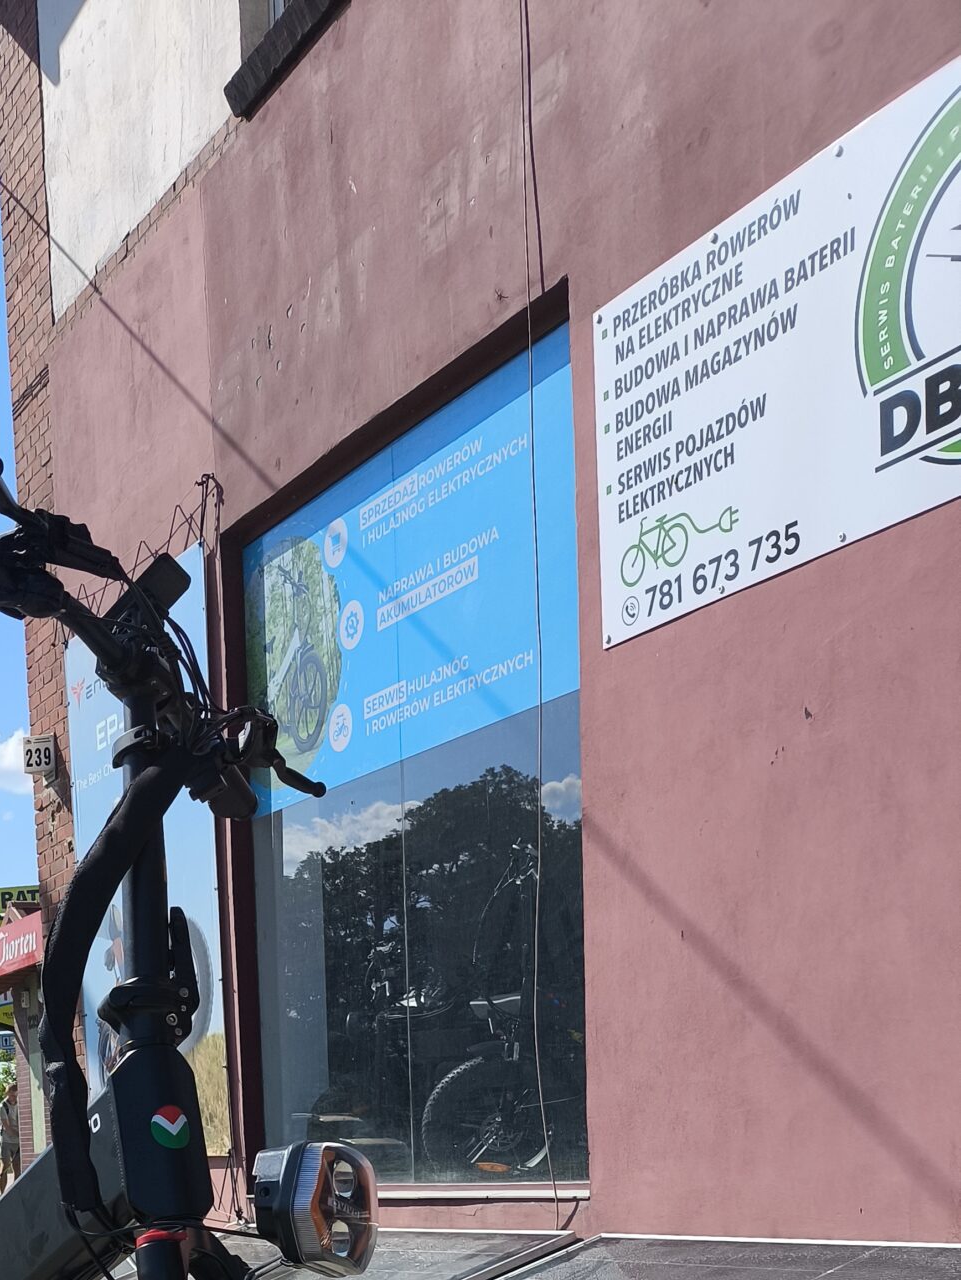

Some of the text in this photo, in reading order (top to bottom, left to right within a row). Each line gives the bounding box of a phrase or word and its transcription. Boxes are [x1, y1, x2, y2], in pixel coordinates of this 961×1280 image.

[884, 164, 933, 269] BATERII
[612, 188, 801, 338] PRZERÓBKA ROWERÓW
[614, 225, 856, 400] BUDOWA I NAPRAWA BATERII
[614, 261, 743, 366] NA ELEKTRYCZNE
[877, 280, 894, 371] SERWIS
[615, 302, 798, 434] BUDOWA MAGAZYNÓW
[361, 436, 483, 527] SPRZEDAŻ ROWERÓW
[428, 432, 528, 508] ELEKTRYCZNYCH
[616, 410, 673, 462] ENERGII
[617, 392, 767, 496] SERWIS POJAZDÓW
[617, 442, 735, 524] ELEKTRYCZNYCH
[377, 562, 435, 605] NAPRAWA
[443, 526, 500, 569] BUDOWA
[378, 561, 477, 627] AKUMULATORÓW
[644, 520, 801, 618] 781 673 735
[365, 655, 470, 715] SERWIS HULAJNÓG
[372, 696, 430, 734] ROWERÓW
[433, 649, 534, 708] ELEKTRYCZNYCH
[25, 746, 51, 768] 239
